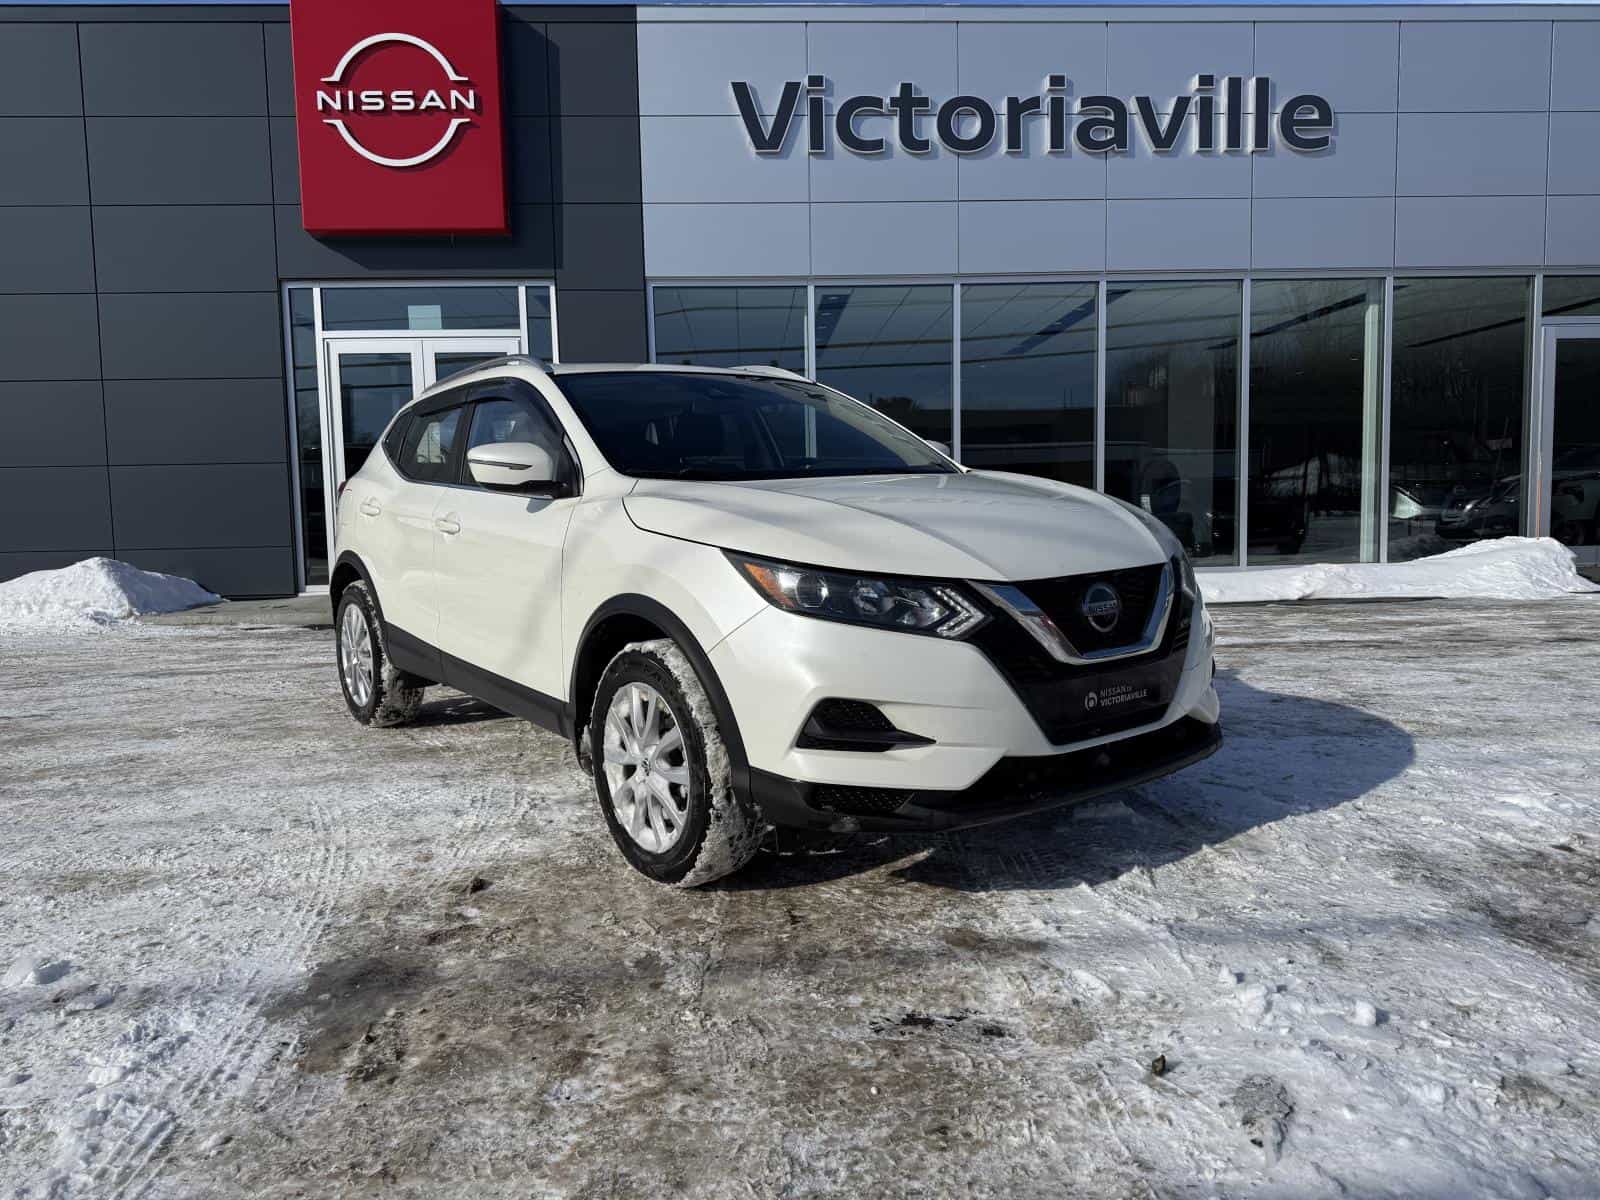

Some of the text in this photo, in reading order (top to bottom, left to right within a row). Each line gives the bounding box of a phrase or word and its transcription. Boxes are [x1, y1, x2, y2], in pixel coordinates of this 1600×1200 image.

[316, 89, 475, 111] NISSAN
[730, 74, 1334, 153] Victoriaville
[1100, 685, 1126, 698] NISSAN
[1101, 689, 1148, 706] VICTORIAVILLE
